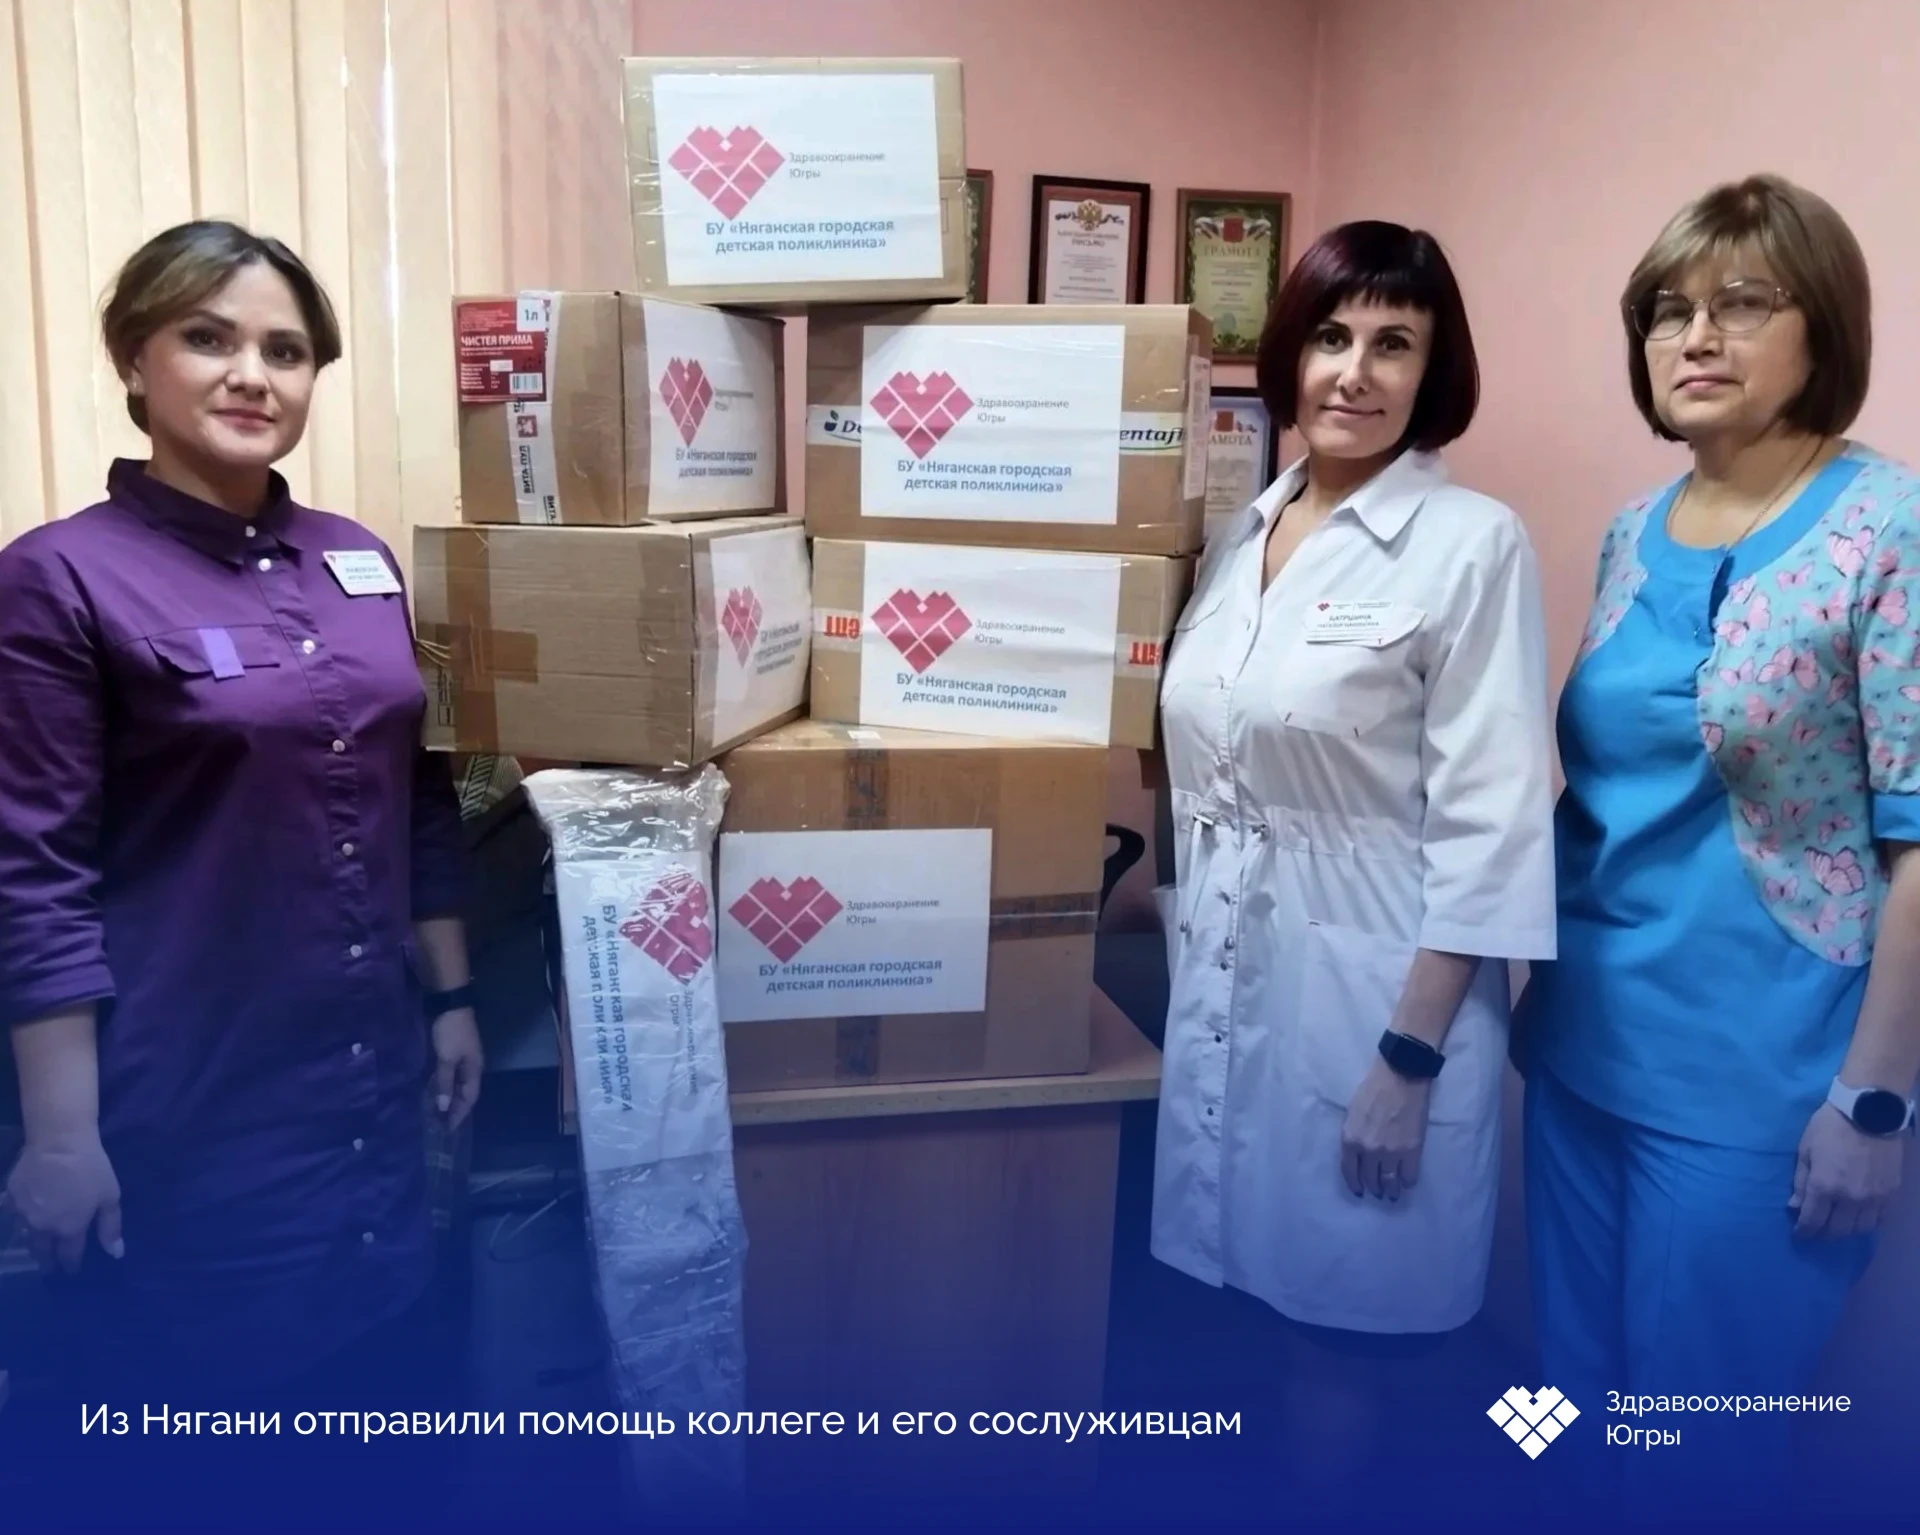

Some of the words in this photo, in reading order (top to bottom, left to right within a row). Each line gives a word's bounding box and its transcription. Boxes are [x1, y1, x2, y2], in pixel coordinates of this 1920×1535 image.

[789, 168, 820, 180] Югры
[706, 222, 725, 236] БУ
[729, 221, 815, 234] «Няганская
[818, 220, 894, 234] городская
[716, 240, 775, 254] детская
[778, 238, 887, 250] поликлиника»
[460, 335, 498, 346] ЧИСТЕЯ
[498, 334, 533, 344] ПРИМА
[977, 413, 1006, 424] Югры
[1208, 434, 1252, 446] АМОТА
[519, 445, 532, 494] ВИТА-ПУЛ
[898, 460, 915, 472] БУ
[918, 460, 997, 475] «Няганская
[1000, 463, 1072, 478] городская
[904, 478, 958, 491] детская
[960, 478, 1064, 493] поликлиника»
[974, 634, 1003, 645] Югры
[896, 673, 914, 685] БУ
[916, 675, 994, 692] «Няганская
[996, 683, 1067, 699] городская
[902, 692, 957, 704] детская
[958, 694, 1058, 714] поликлиника»
[602, 904, 617, 925] БУ
[846, 914, 876, 925] Югры
[758, 964, 778, 977] БУ
[782, 962, 866, 976] «Няганская
[869, 960, 942, 974] городская
[766, 980, 824, 994] детская
[828, 975, 934, 990] поликлиника»
